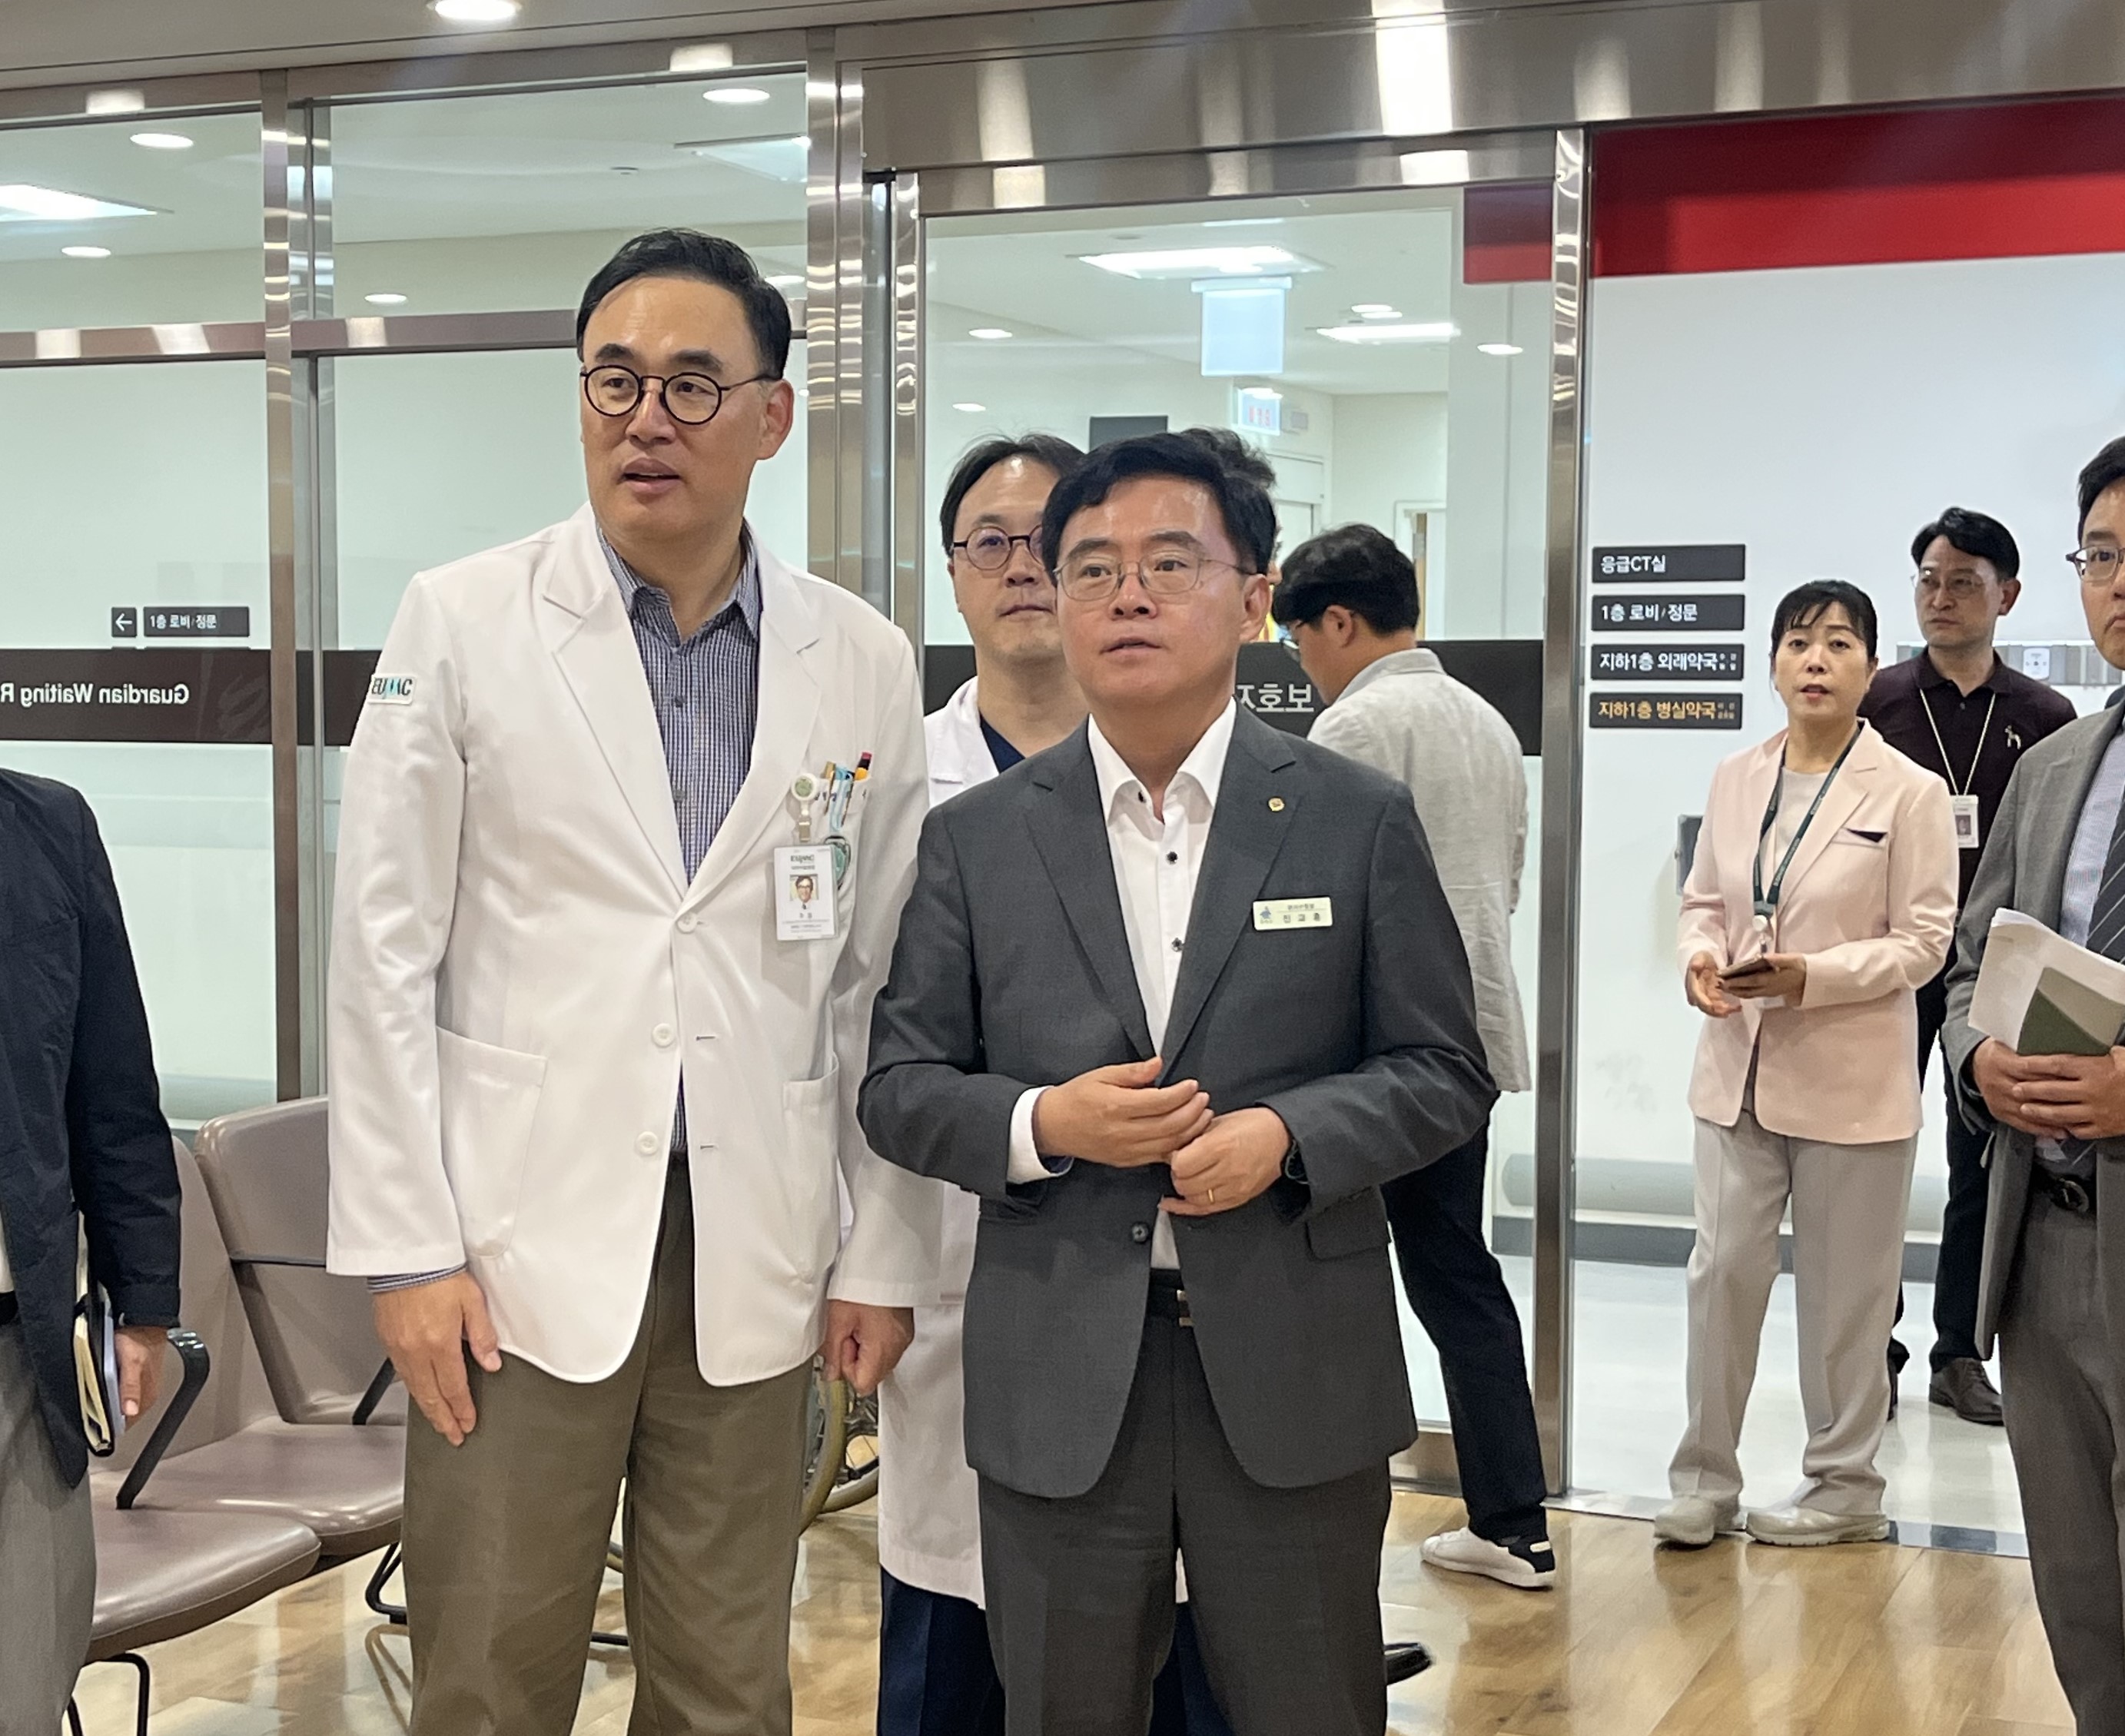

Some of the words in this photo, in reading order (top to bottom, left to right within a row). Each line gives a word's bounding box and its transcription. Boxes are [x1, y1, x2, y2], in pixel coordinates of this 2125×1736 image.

[1601, 554, 1666, 574] 응급CT실
[150, 614, 167, 629] 1층
[1602, 603, 1625, 622] 1층
[1599, 652, 1654, 672] 지하1층
[1657, 652, 1718, 672] 외래약국
[1598, 701, 1652, 719] 지하1층
[1656, 701, 1716, 720] 병실약국
